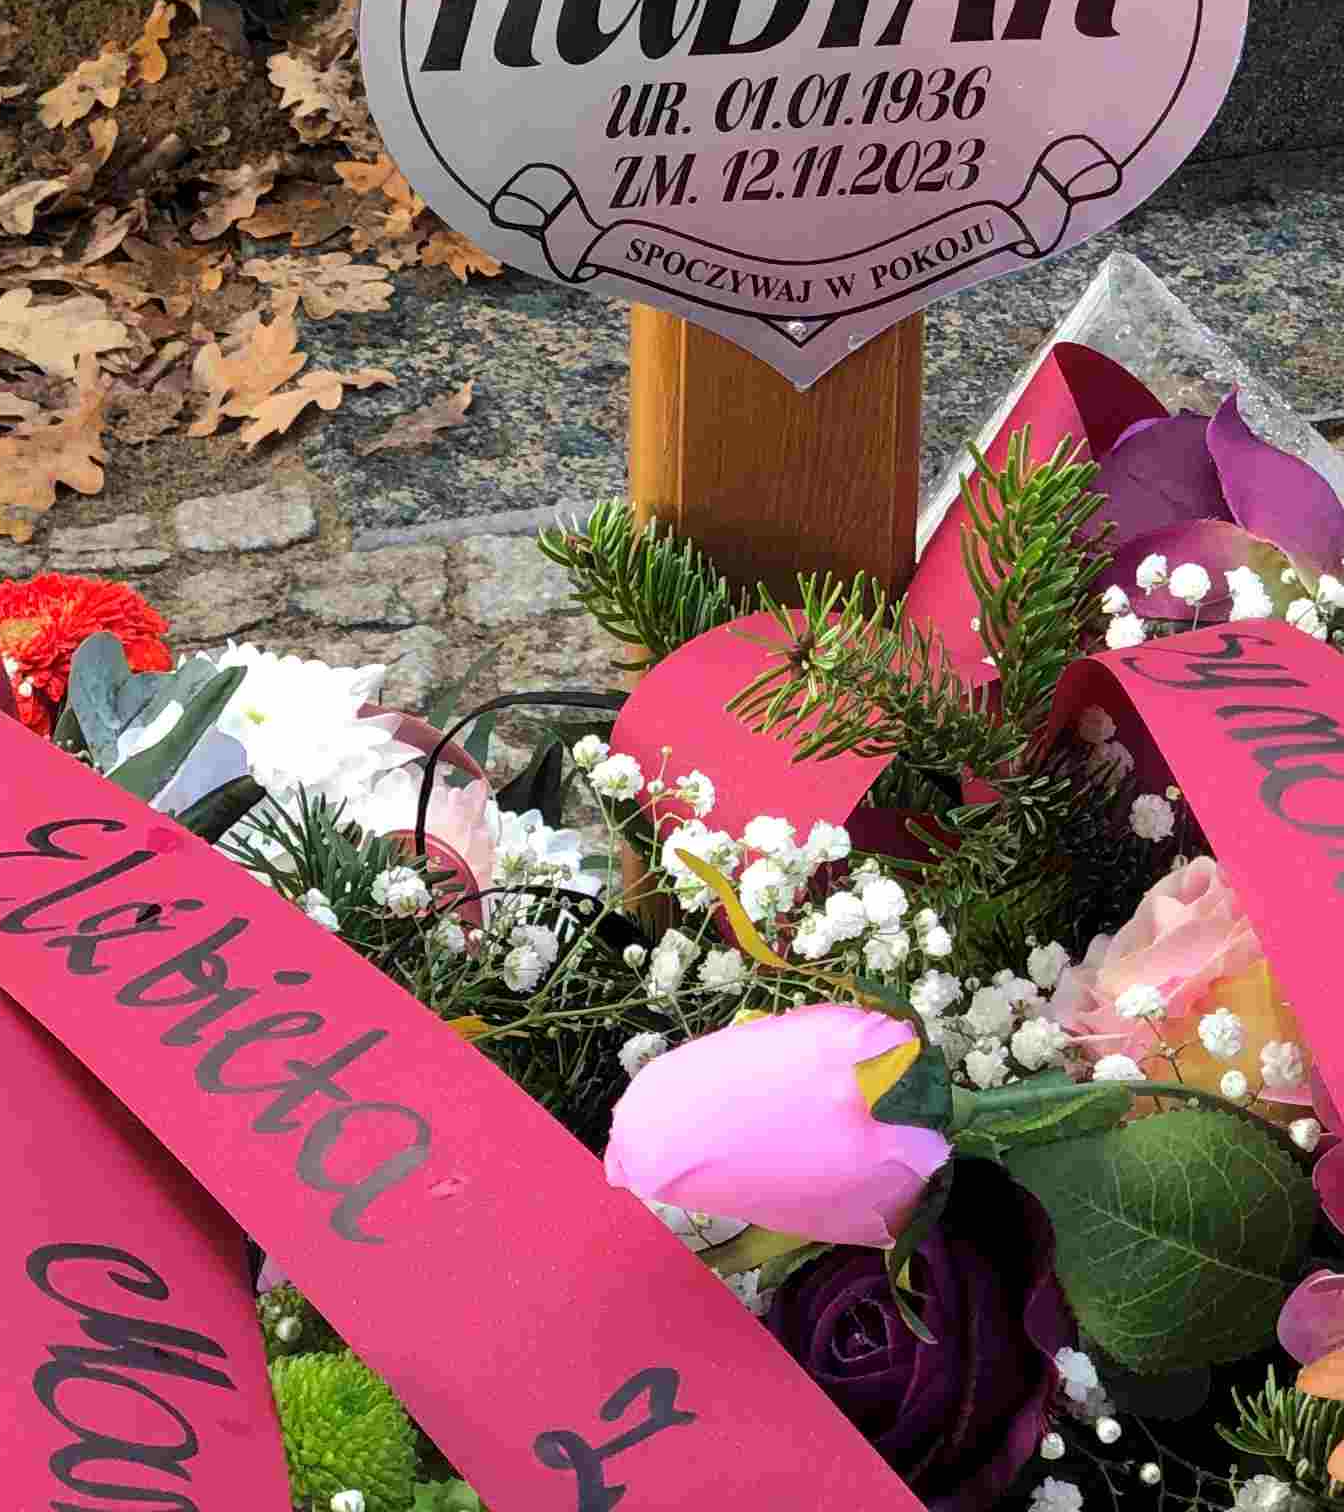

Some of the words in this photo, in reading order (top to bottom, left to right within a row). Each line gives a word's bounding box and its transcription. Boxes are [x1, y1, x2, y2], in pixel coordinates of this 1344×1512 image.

[605, 81, 692, 139] UR.
[714, 65, 992, 133] 01.01.1936
[609, 153, 698, 209] ZM.
[721, 138, 986, 202] 12.11.2023
[625, 237, 814, 304] SPOCZYWAJ
[824, 274, 856, 300] W
[870, 218, 996, 290] POKOJU
